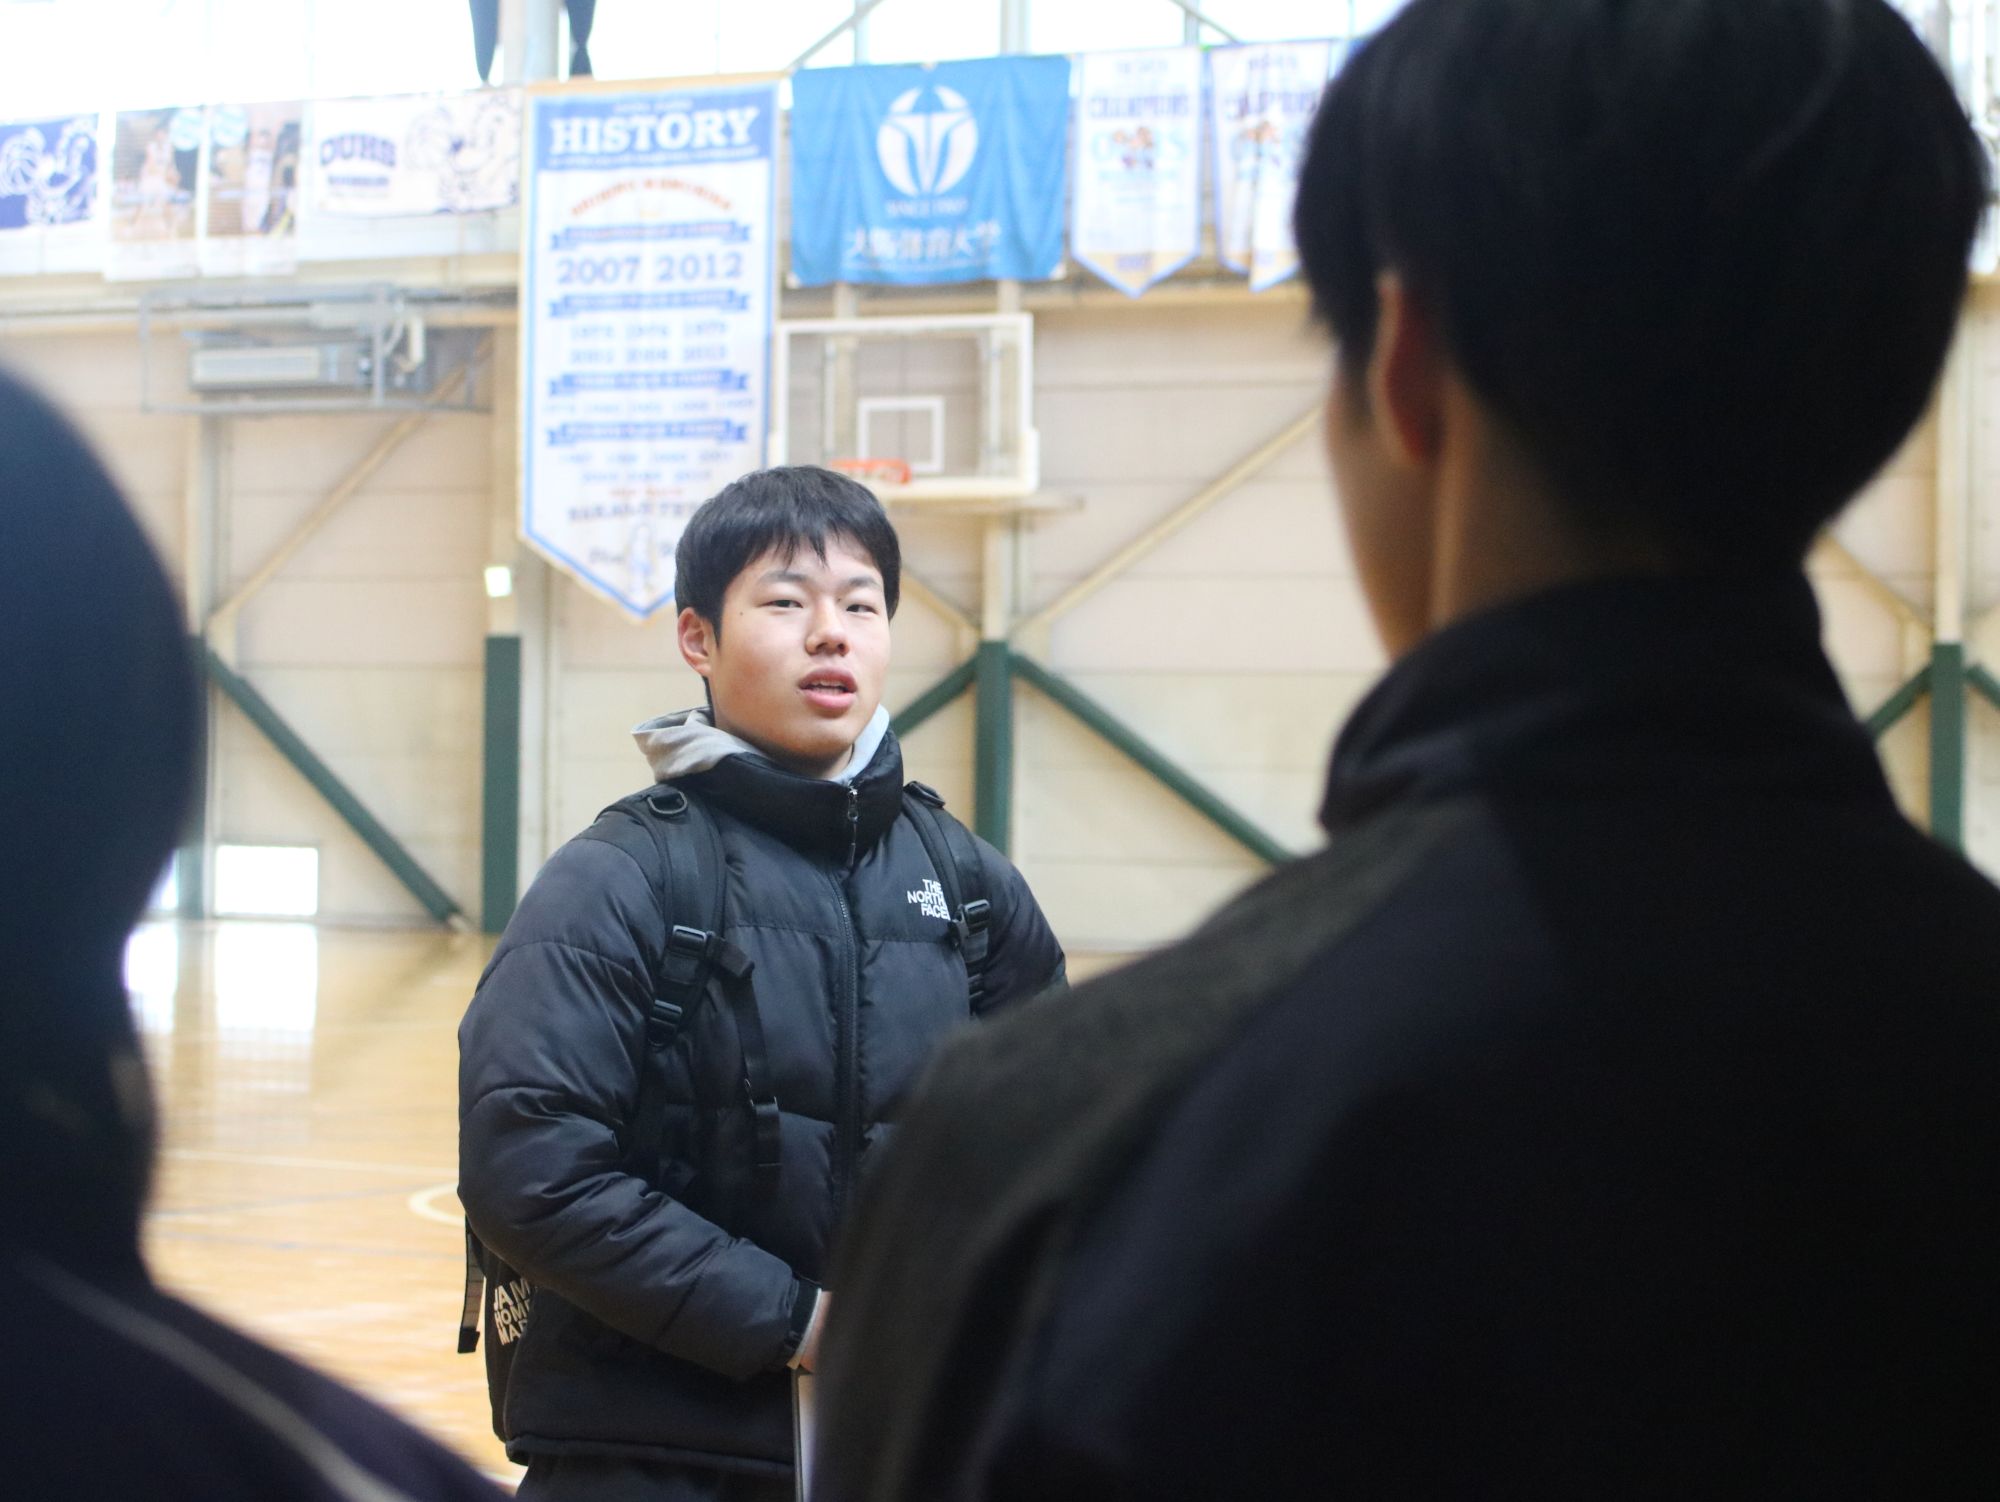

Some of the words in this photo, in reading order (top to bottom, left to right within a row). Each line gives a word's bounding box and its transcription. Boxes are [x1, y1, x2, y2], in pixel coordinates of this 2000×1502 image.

[548, 106, 761, 156] HISTORY
[556, 254, 642, 285] 2007
[656, 251, 743, 282] 2012
[921, 878, 943, 893] THE
[907, 890, 947, 906] NORTH
[921, 903, 951, 921] FACE
